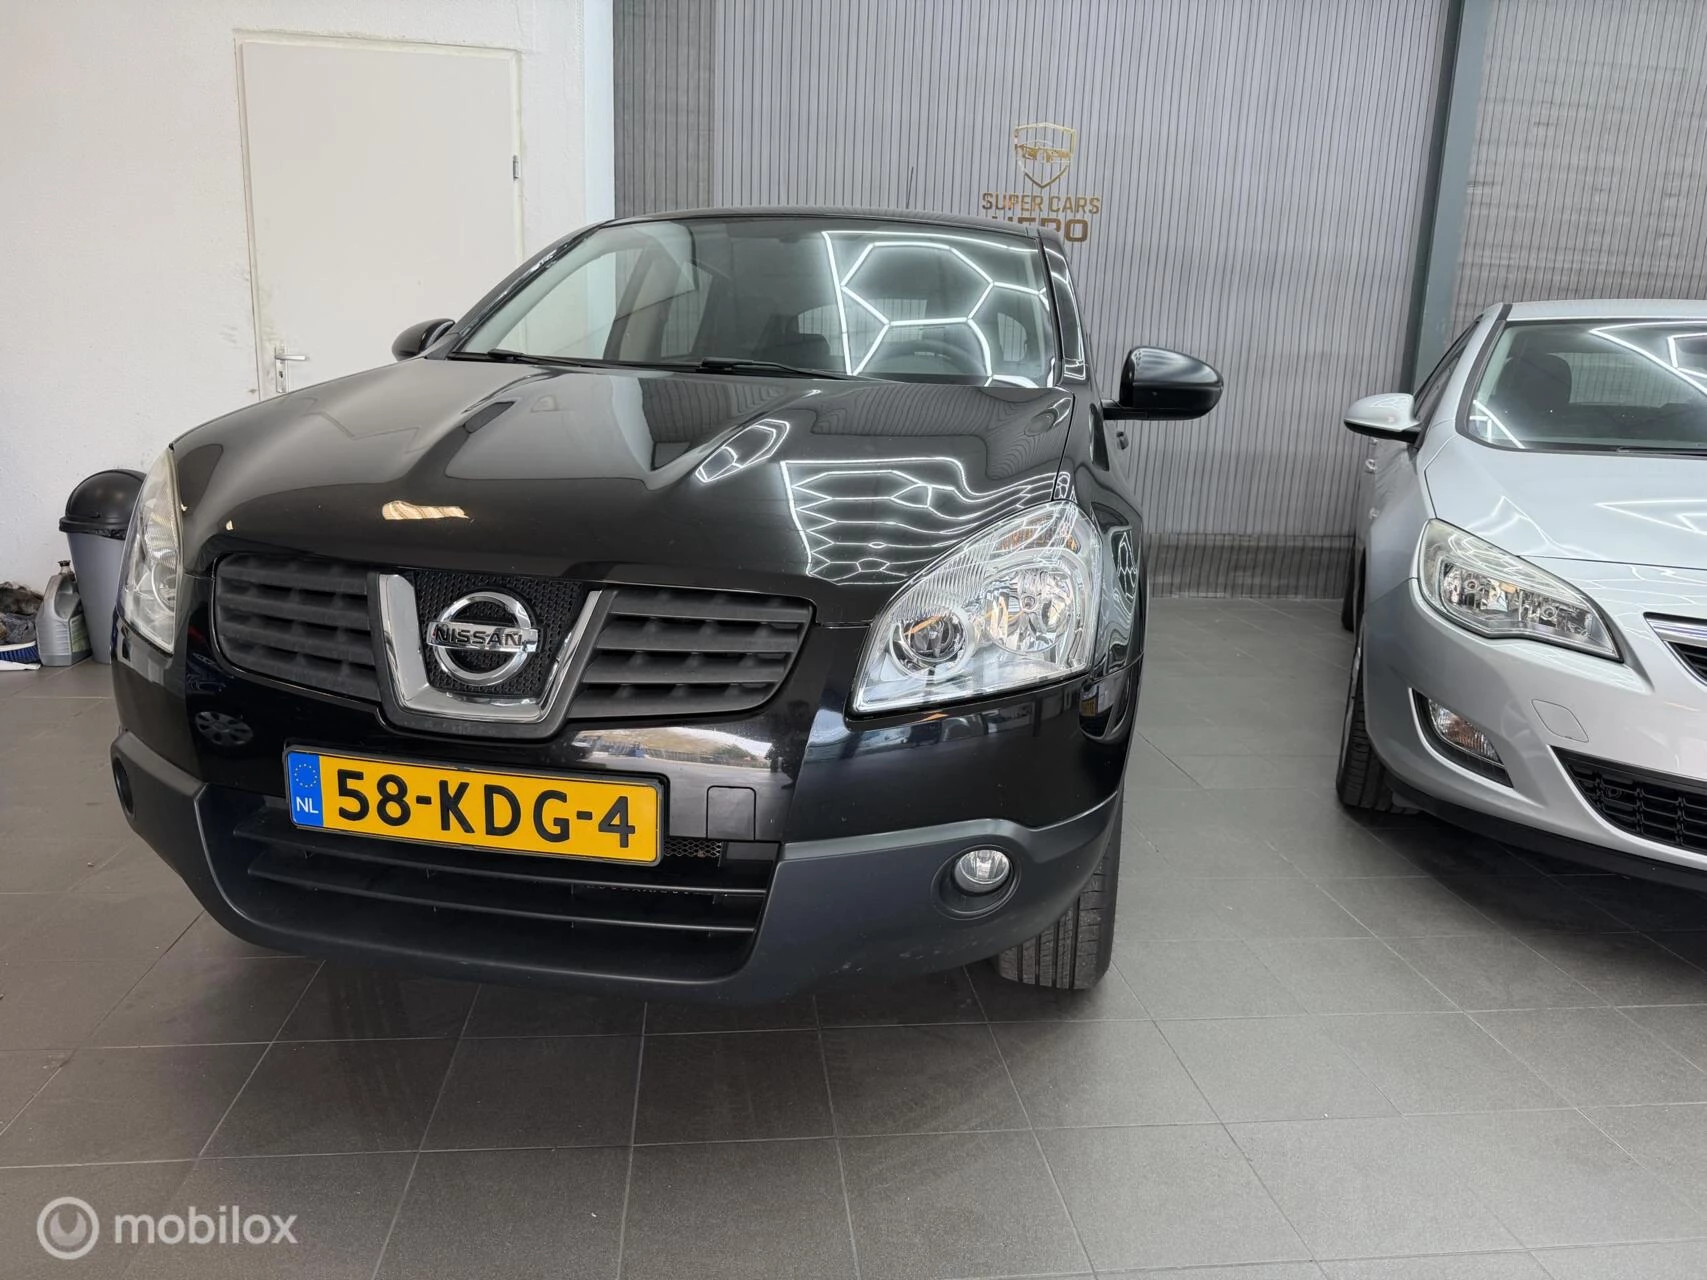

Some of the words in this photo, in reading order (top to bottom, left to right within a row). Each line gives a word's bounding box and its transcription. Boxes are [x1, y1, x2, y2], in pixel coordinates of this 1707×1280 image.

[982, 192, 1043, 212] SUPER
[1049, 196, 1101, 215] CARS
[433, 624, 522, 647] NISSAN
[296, 796, 319, 815] NL
[337, 768, 636, 849] 58-KDG-4
